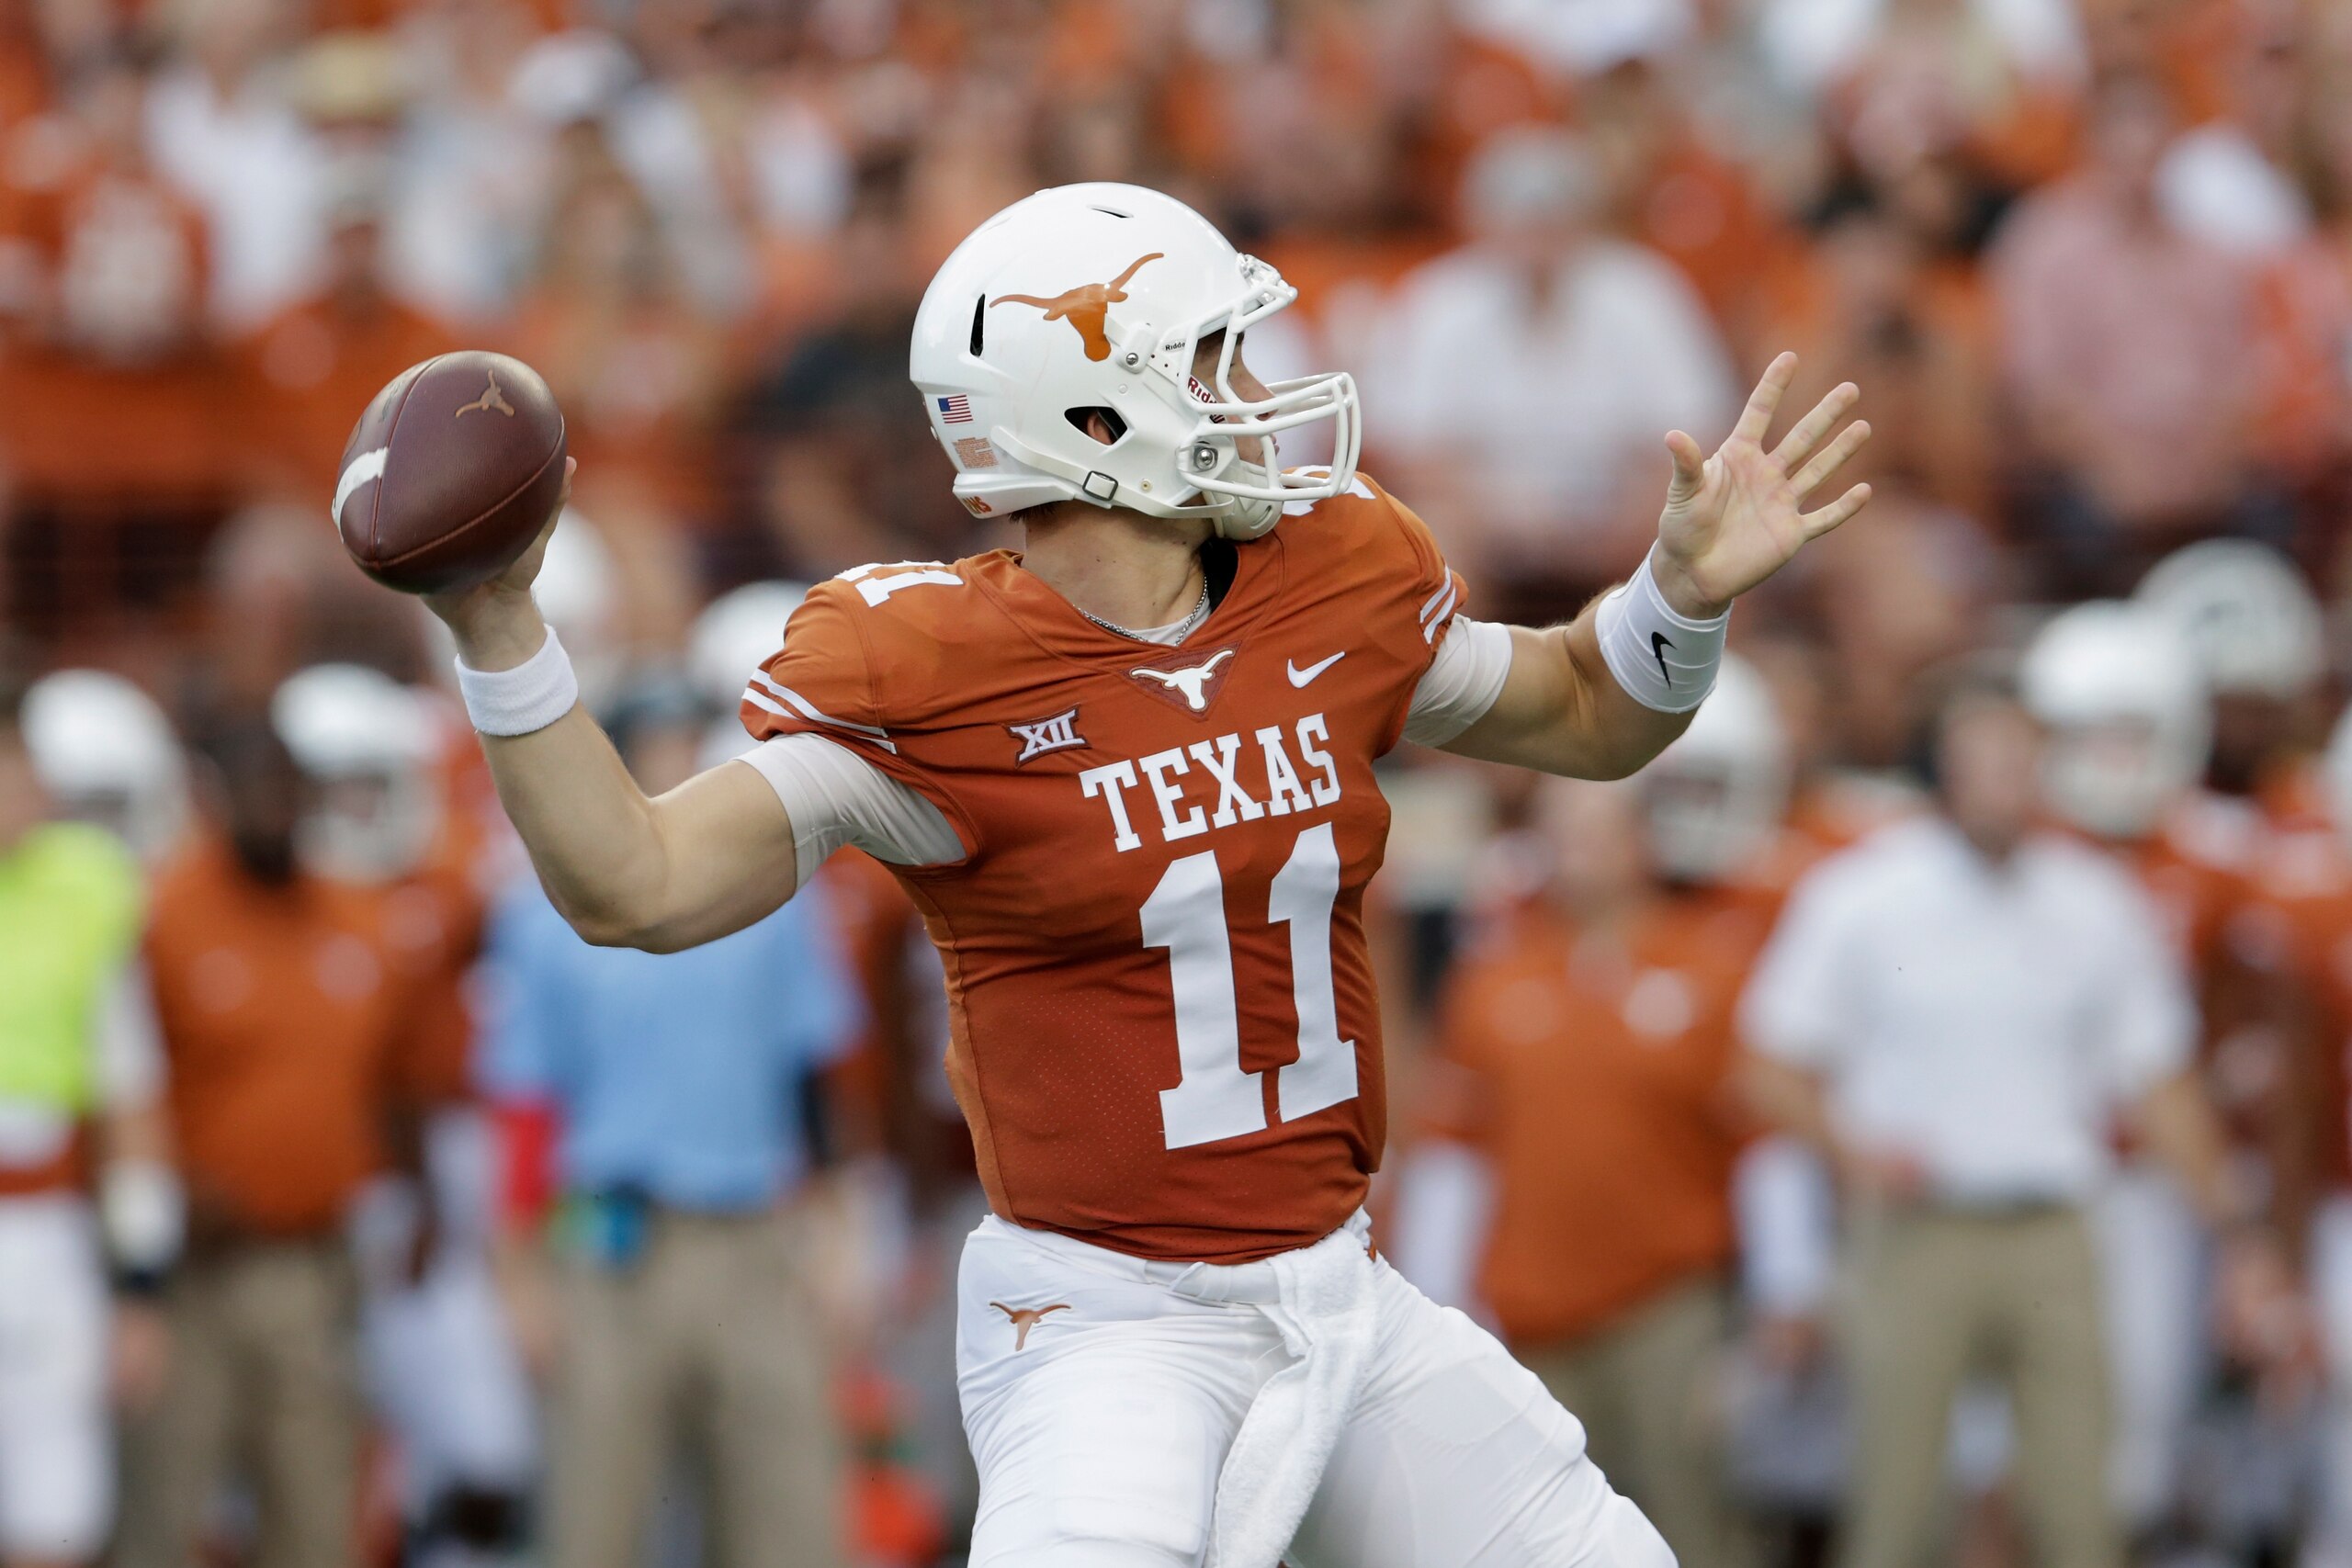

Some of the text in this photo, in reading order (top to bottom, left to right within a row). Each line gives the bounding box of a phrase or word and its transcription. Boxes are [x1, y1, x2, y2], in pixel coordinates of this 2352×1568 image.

[1165, 342, 1185, 351] Ridde
[1010, 709, 1086, 761] XII
[1079, 712, 1341, 852] TEXAS
[1139, 821, 1359, 1150] 11
